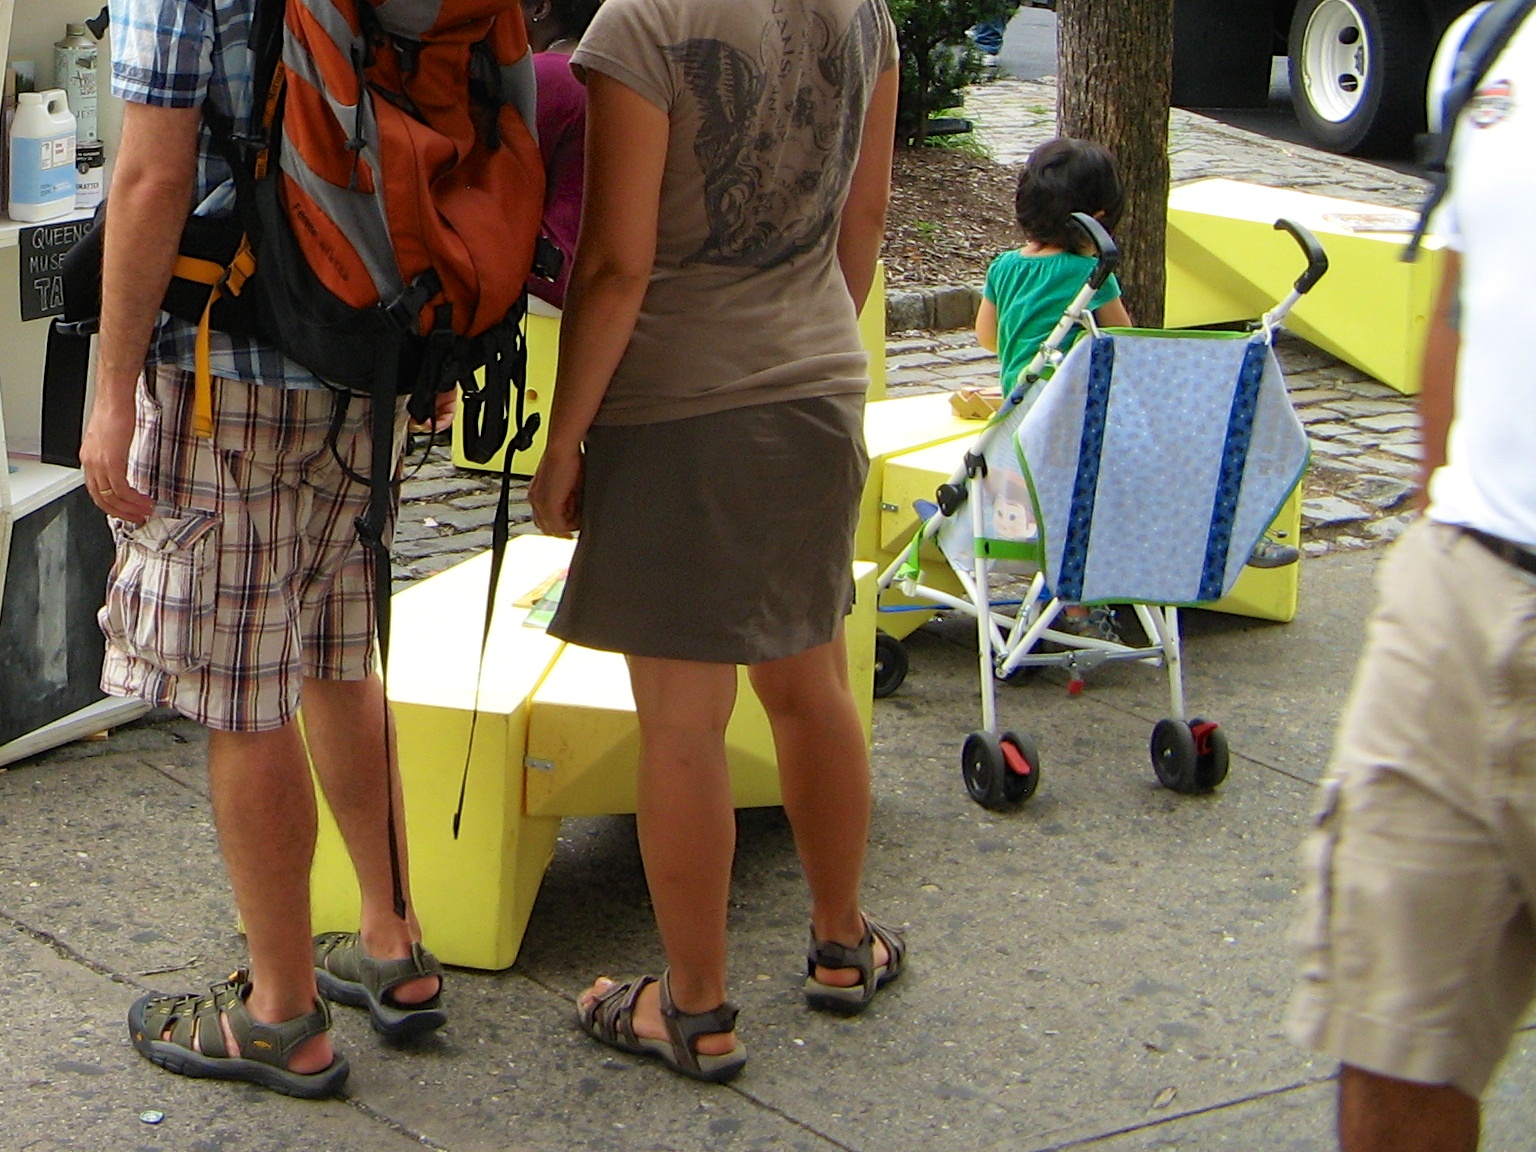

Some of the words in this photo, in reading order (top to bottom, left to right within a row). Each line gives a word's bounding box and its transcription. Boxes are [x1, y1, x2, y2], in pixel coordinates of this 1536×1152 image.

[31, 223, 93, 249] QUEENS
[29, 253, 65, 272] MUSE
[33, 278, 65, 311] TA
